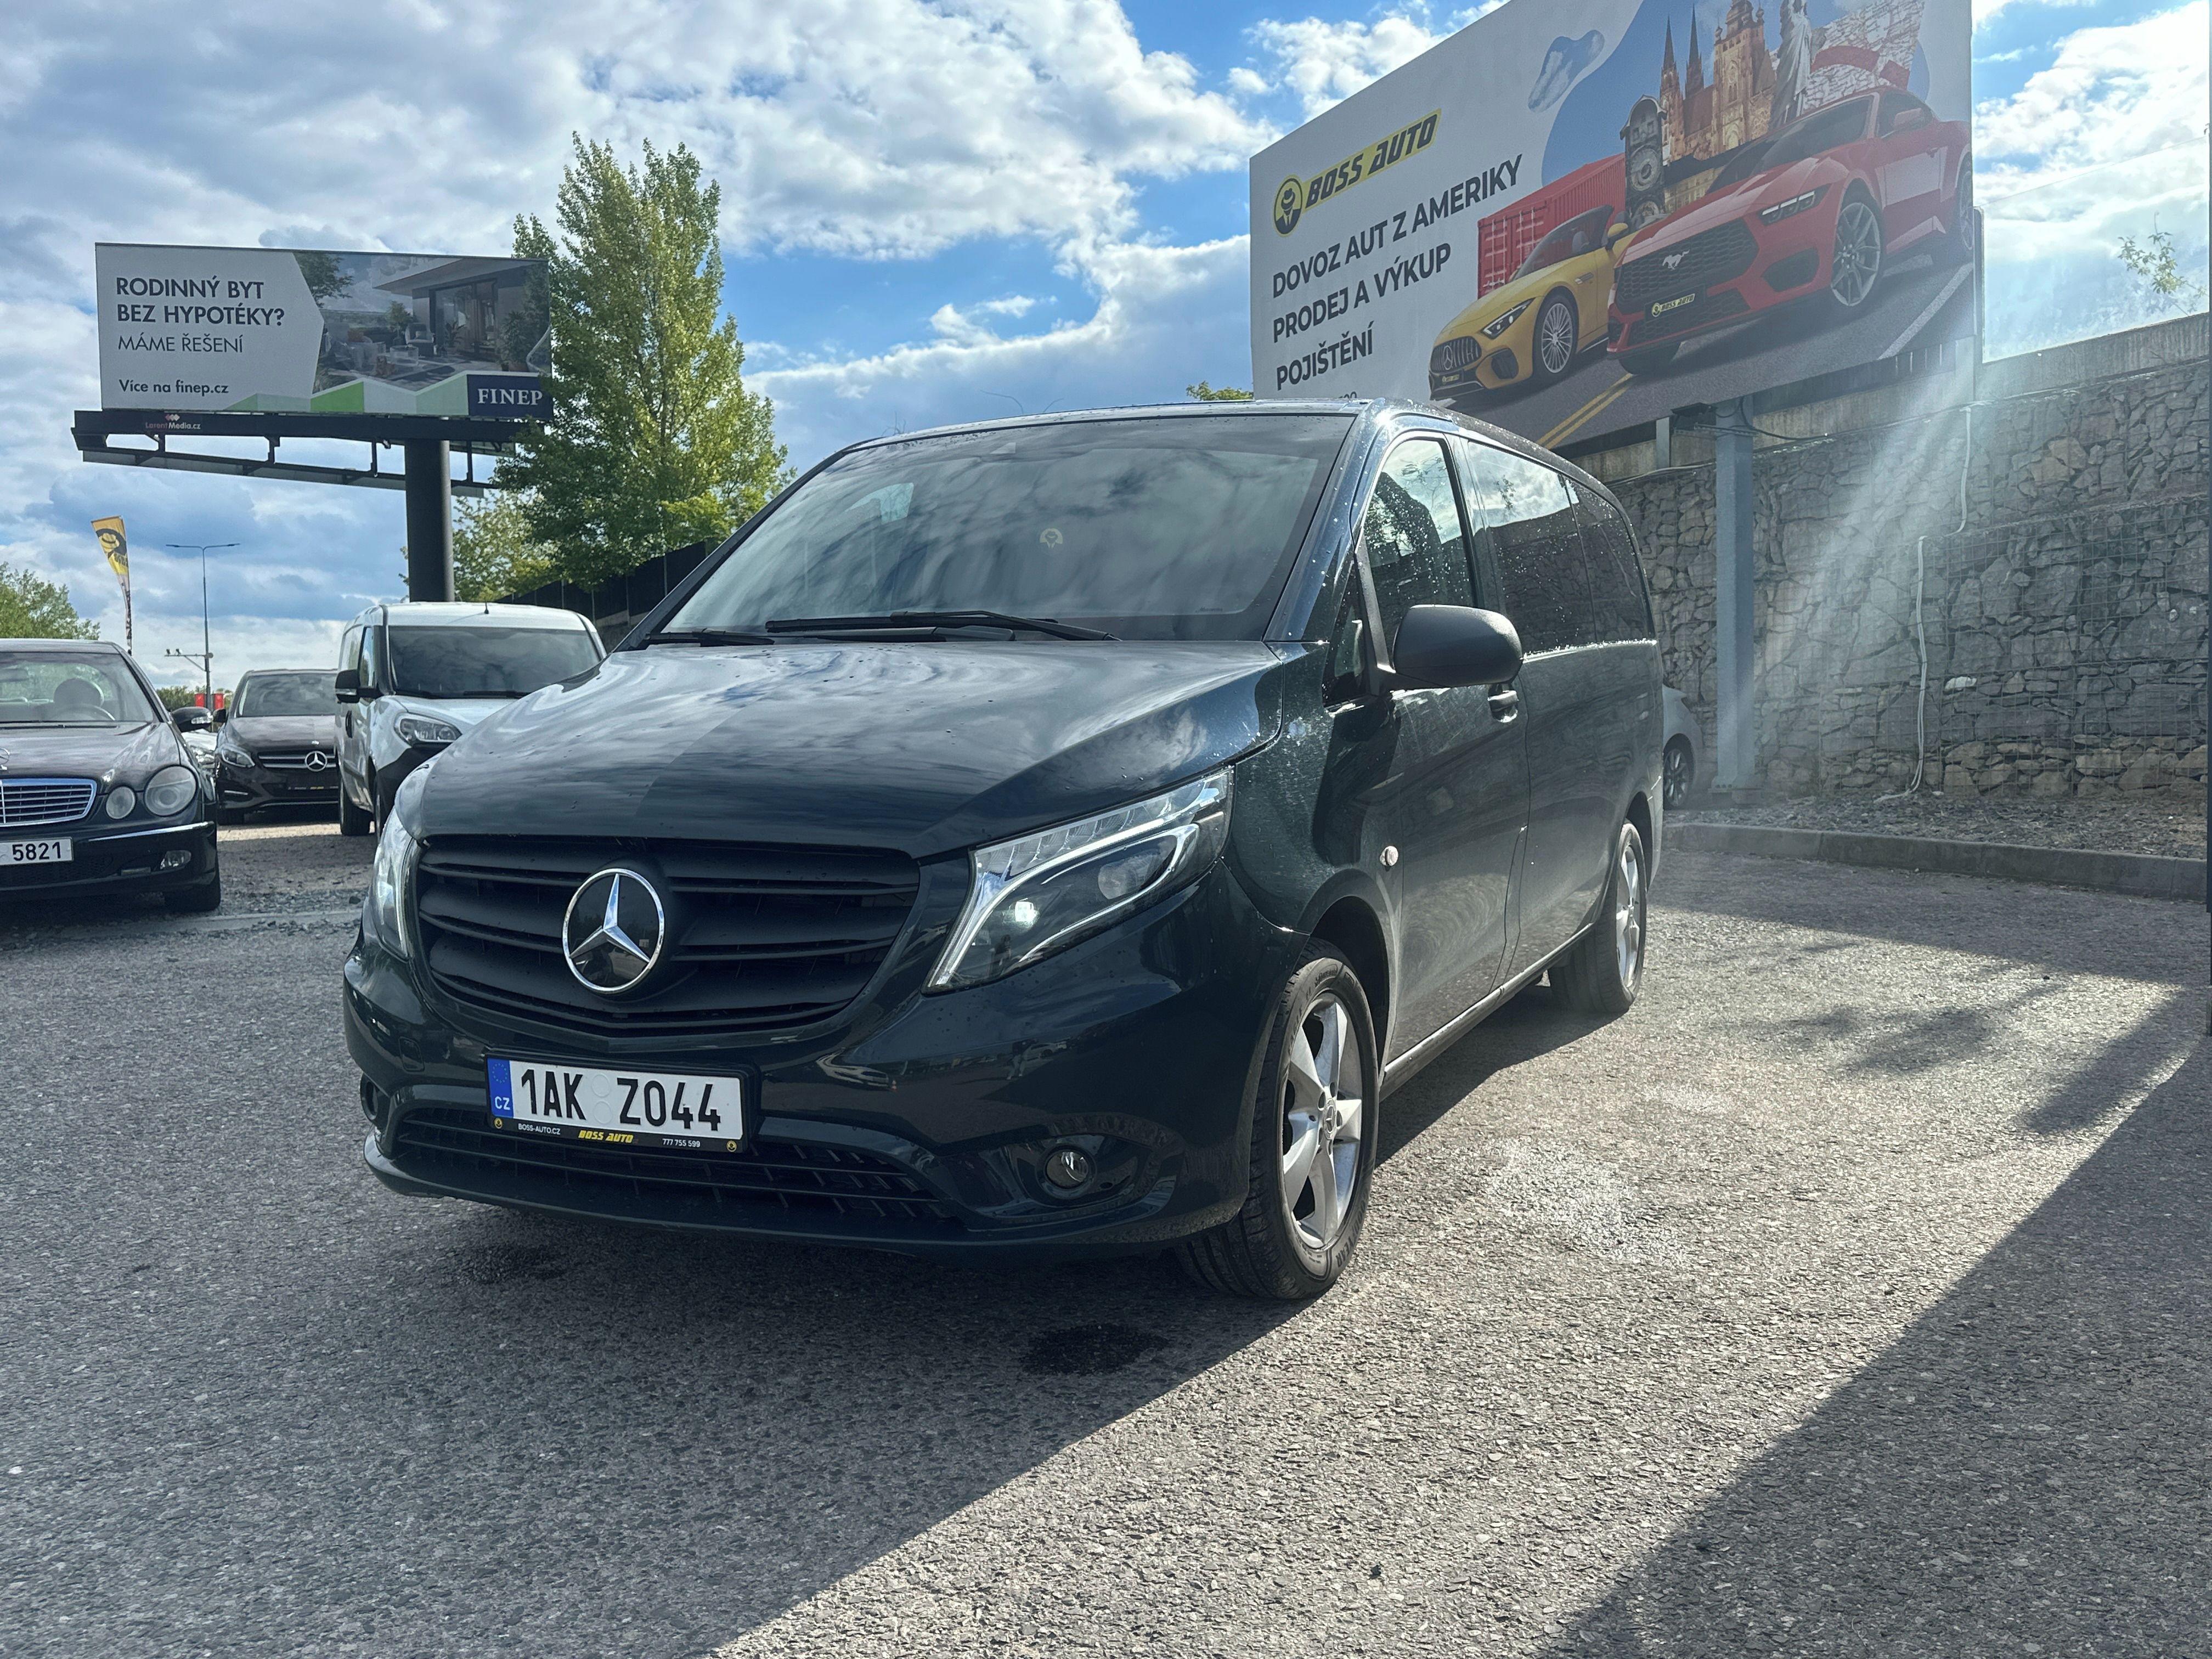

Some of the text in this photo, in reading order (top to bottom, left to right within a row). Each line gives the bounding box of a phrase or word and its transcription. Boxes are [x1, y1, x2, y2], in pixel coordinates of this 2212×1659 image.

[1305, 114, 1437, 209] BOSS AUTO
[1273, 154, 1522, 298] DOVOZ AUT Z AMERIKY
[116, 275, 264, 298] RODINNÝ BYT
[1273, 242, 1451, 343] PRODEJ A VÝKUP
[117, 303, 284, 326] BEZ HYPOTÉKY?
[118, 332, 243, 353] MÁME ŘEŠENÍ
[1277, 320, 1375, 391] POJIŠTĚNÍ
[119, 380, 229, 397] Více na finep.cz
[478, 388, 543, 405] FINEP
[12, 842, 61, 861] 5821
[494, 1096, 511, 1111] CZ
[521, 1069, 721, 1131] 1AK Z044
[518, 1124, 561, 1135] BOSS-AUTO.CZ
[578, 1130, 604, 1141] BOSS
[605, 1133, 634, 1143] AUTO
